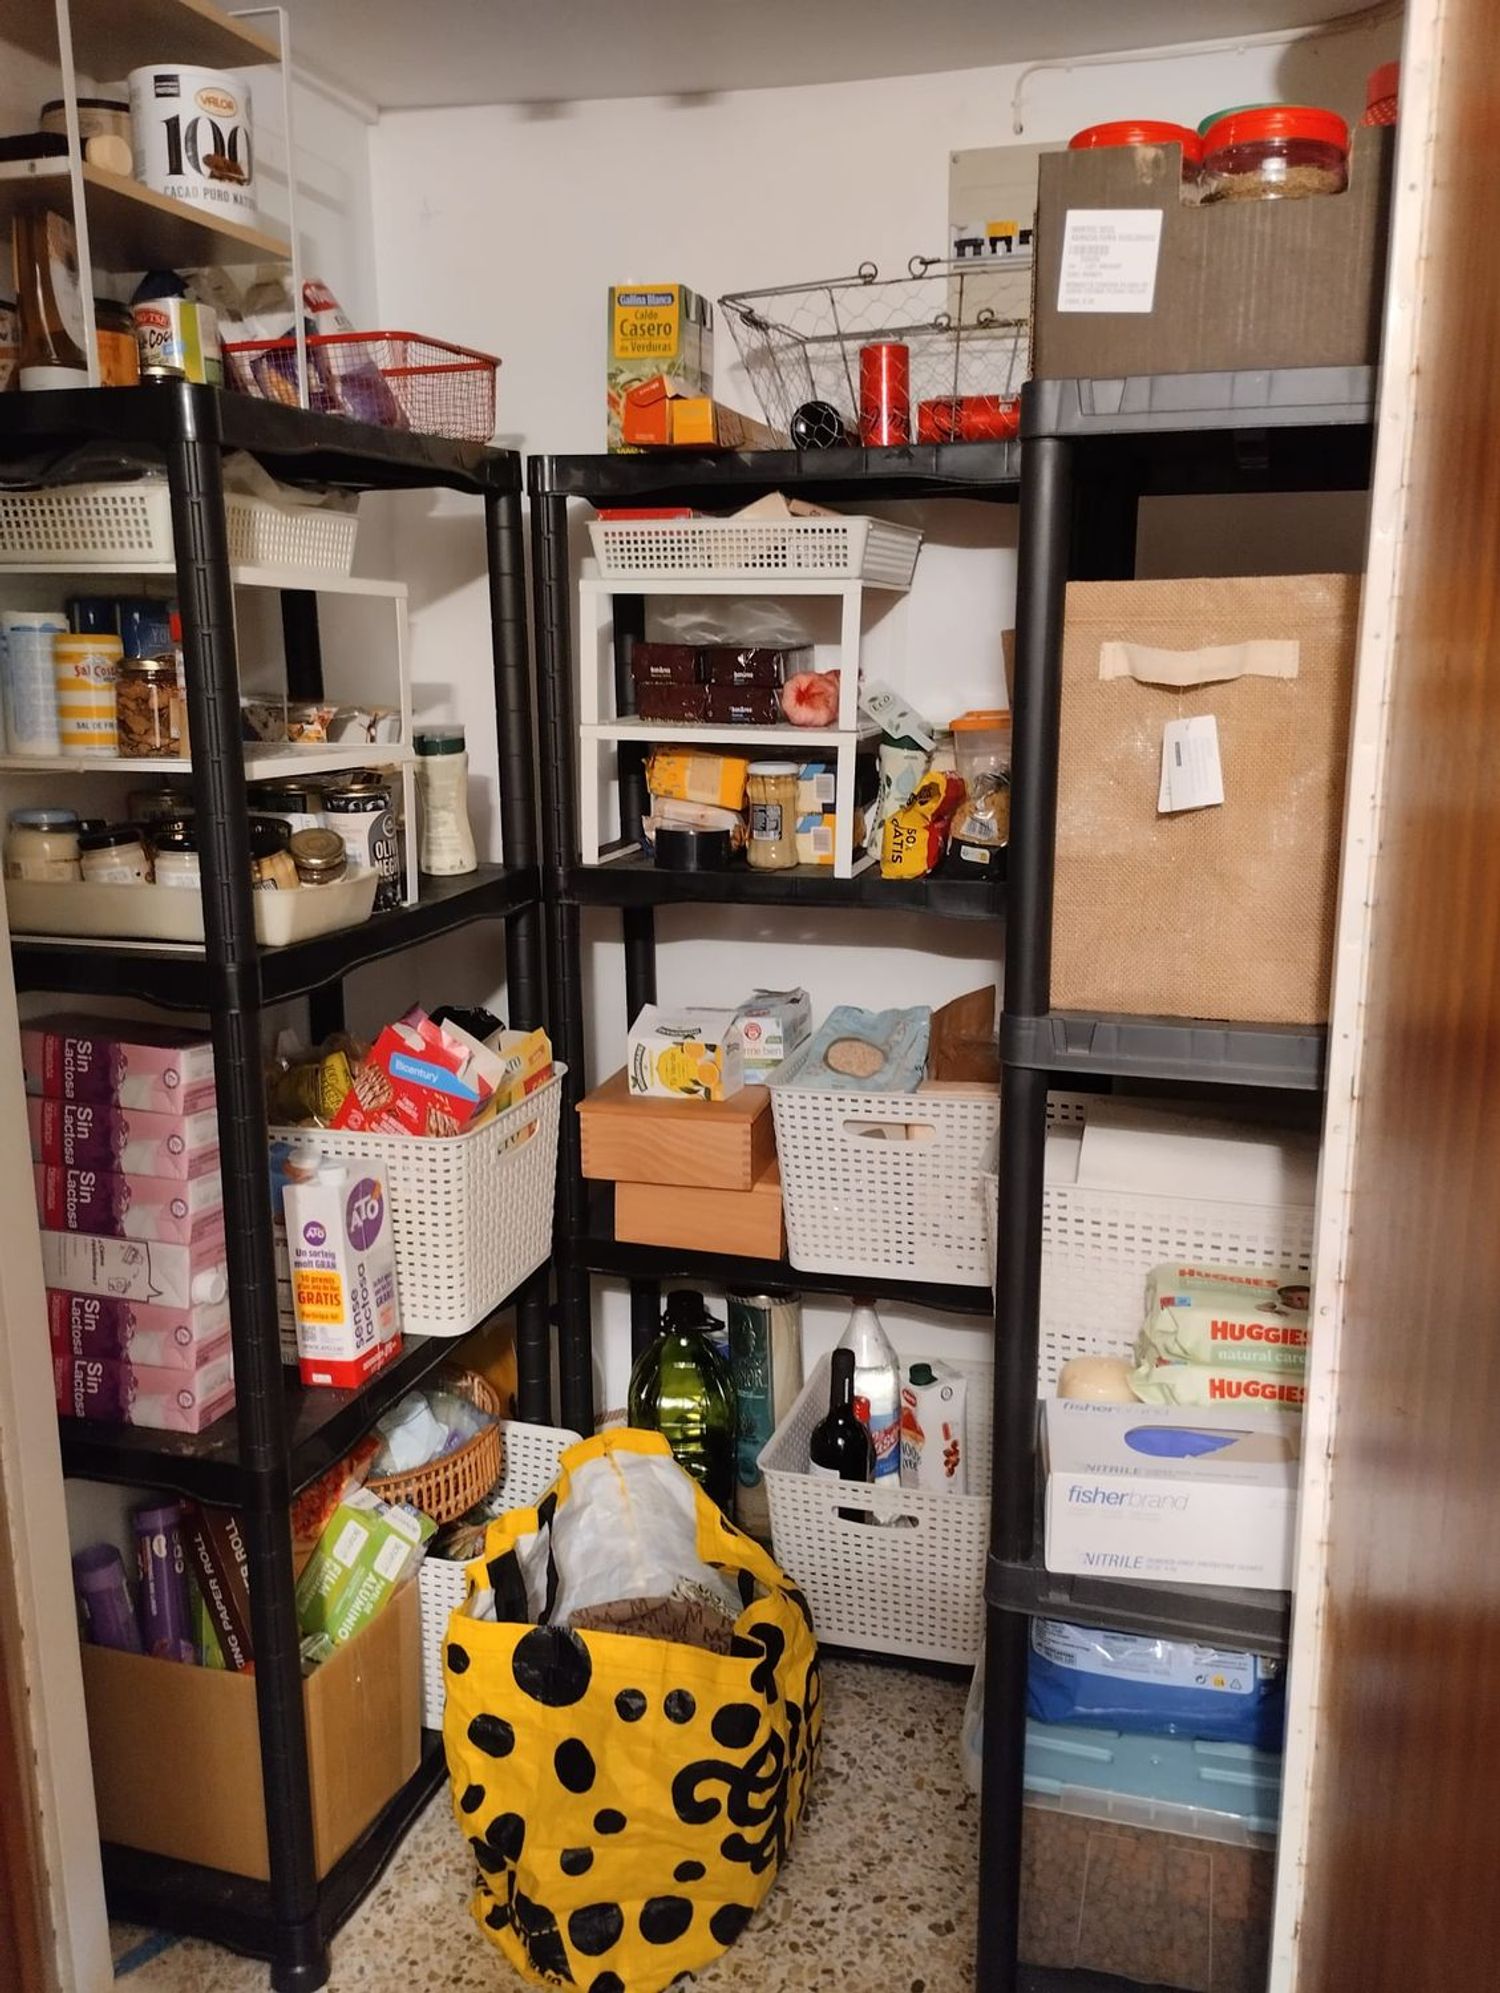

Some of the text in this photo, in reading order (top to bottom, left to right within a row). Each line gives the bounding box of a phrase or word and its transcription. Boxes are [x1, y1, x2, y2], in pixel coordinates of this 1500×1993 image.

[161, 113, 253, 187] 100
[164, 185, 200, 199] CACAO
[203, 188, 230, 203] PURO
[620, 318, 672, 338] Casero
[634, 308, 658, 320] Caldo
[631, 341, 671, 353] Verduras
[74, 664, 91, 678] Sal
[76, 721, 90, 731] SAL
[64, 1038, 76, 1099] Lactosa
[77, 1040, 92, 1073] Sin
[64, 1104, 76, 1166] Lactosa
[77, 1106, 92, 1139] Sin
[67, 1169, 78, 1229] Lactosa
[80, 1171, 95, 1204] Sin
[350, 1197, 380, 1230] ATO
[305, 1227, 326, 1239] ATO
[296, 1249, 307, 1258] Un
[1178, 1268, 1280, 1289] HUGGIES
[85, 1299, 100, 1332] Sin
[297, 1292, 341, 1307] GRATIS
[358, 1262, 375, 1344] lactosa
[72, 1297, 83, 1356] Lactosa
[351, 1288, 365, 1349] sense
[1218, 1350, 1272, 1362] natural
[75, 1361, 86, 1418] Lactosa
[88, 1362, 103, 1394] Sin
[1068, 1484, 1190, 1511] fisherbrand
[194, 1532, 215, 1575] ROLL
[226, 1517, 247, 1563] ROLL
[1084, 1551, 1143, 1570] NITRILE
[209, 1578, 233, 1631] PAPER
[338, 1570, 378, 1640] ALUMINIO
